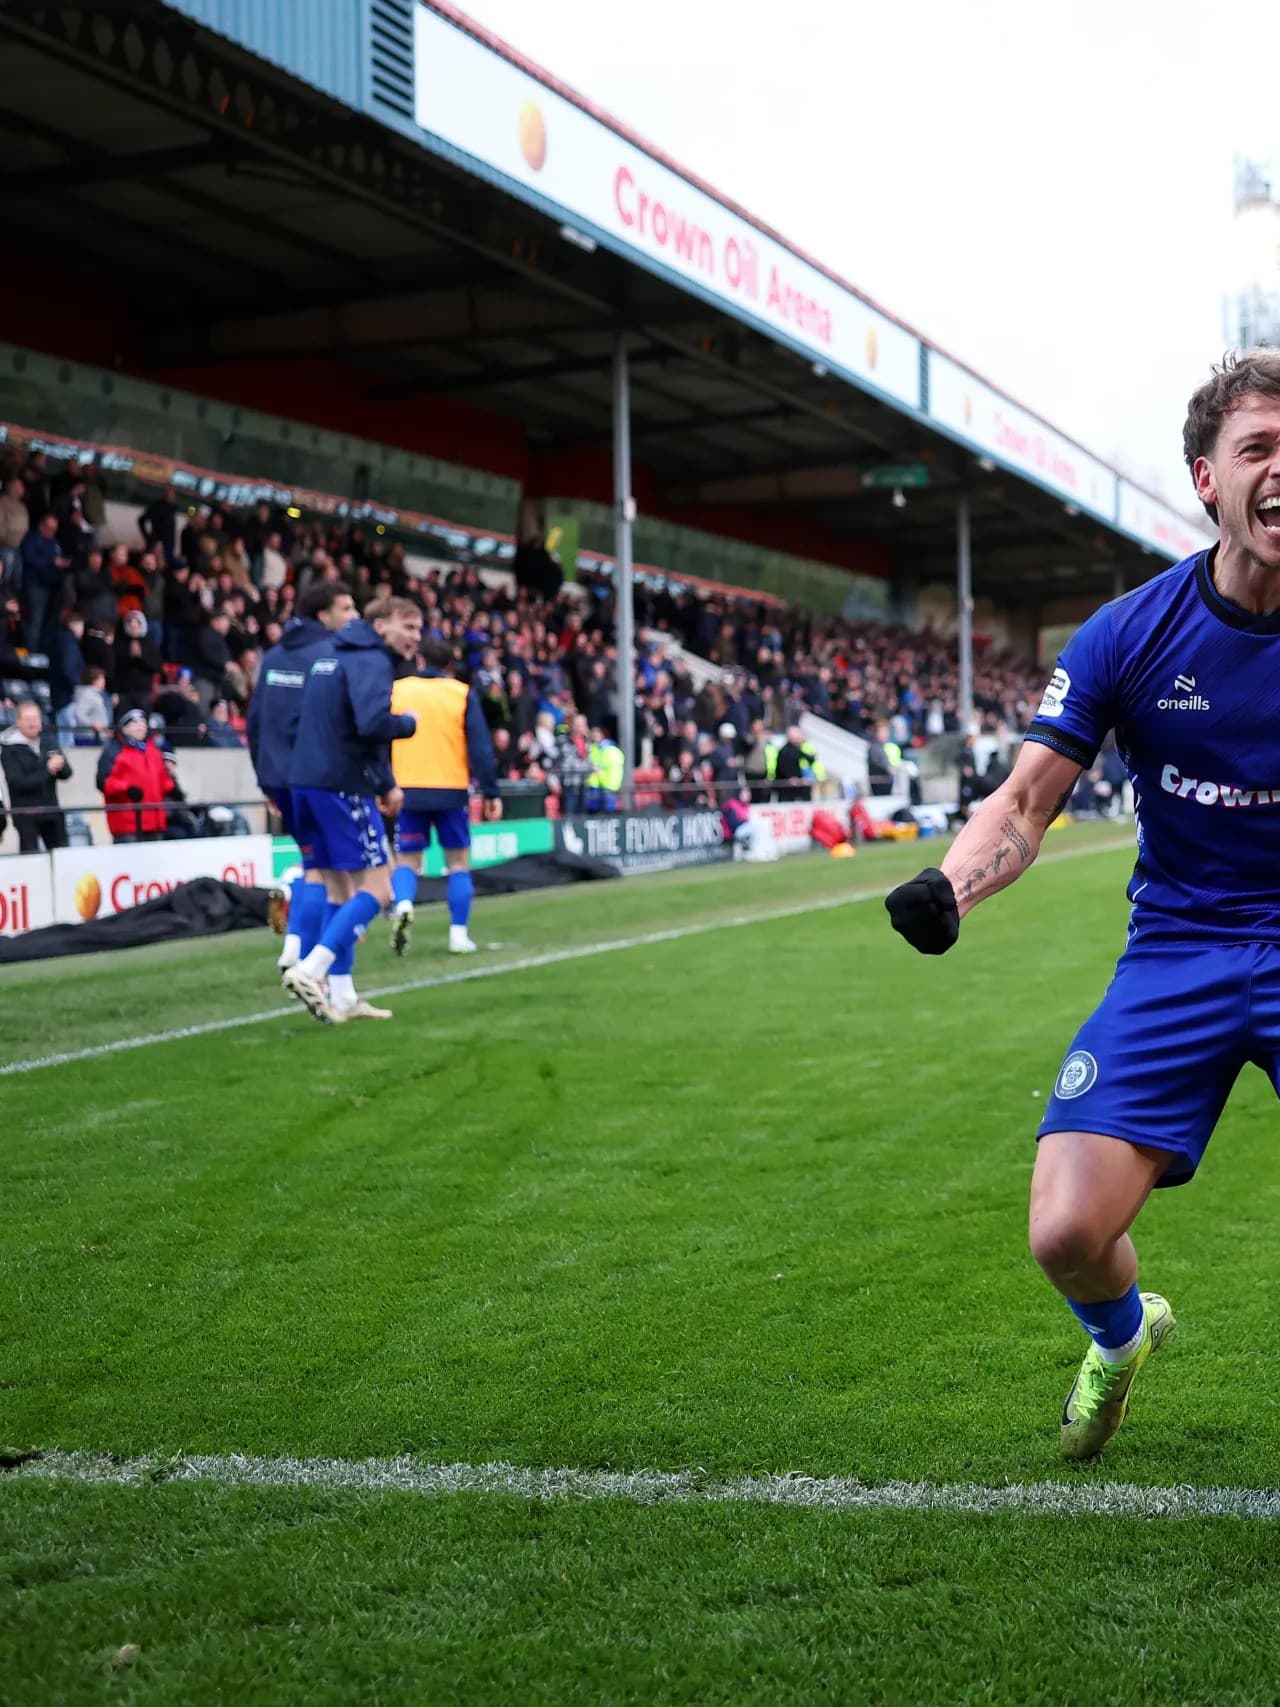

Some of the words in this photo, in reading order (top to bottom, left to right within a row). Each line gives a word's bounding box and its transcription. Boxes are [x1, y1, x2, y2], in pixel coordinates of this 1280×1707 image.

[613, 165, 715, 276] Crown
[723, 235, 759, 300] Oil
[766, 264, 833, 344] Arena
[584, 818, 622, 856] THE
[625, 815, 681, 852] FLYING
[682, 811, 725, 848] HORS
